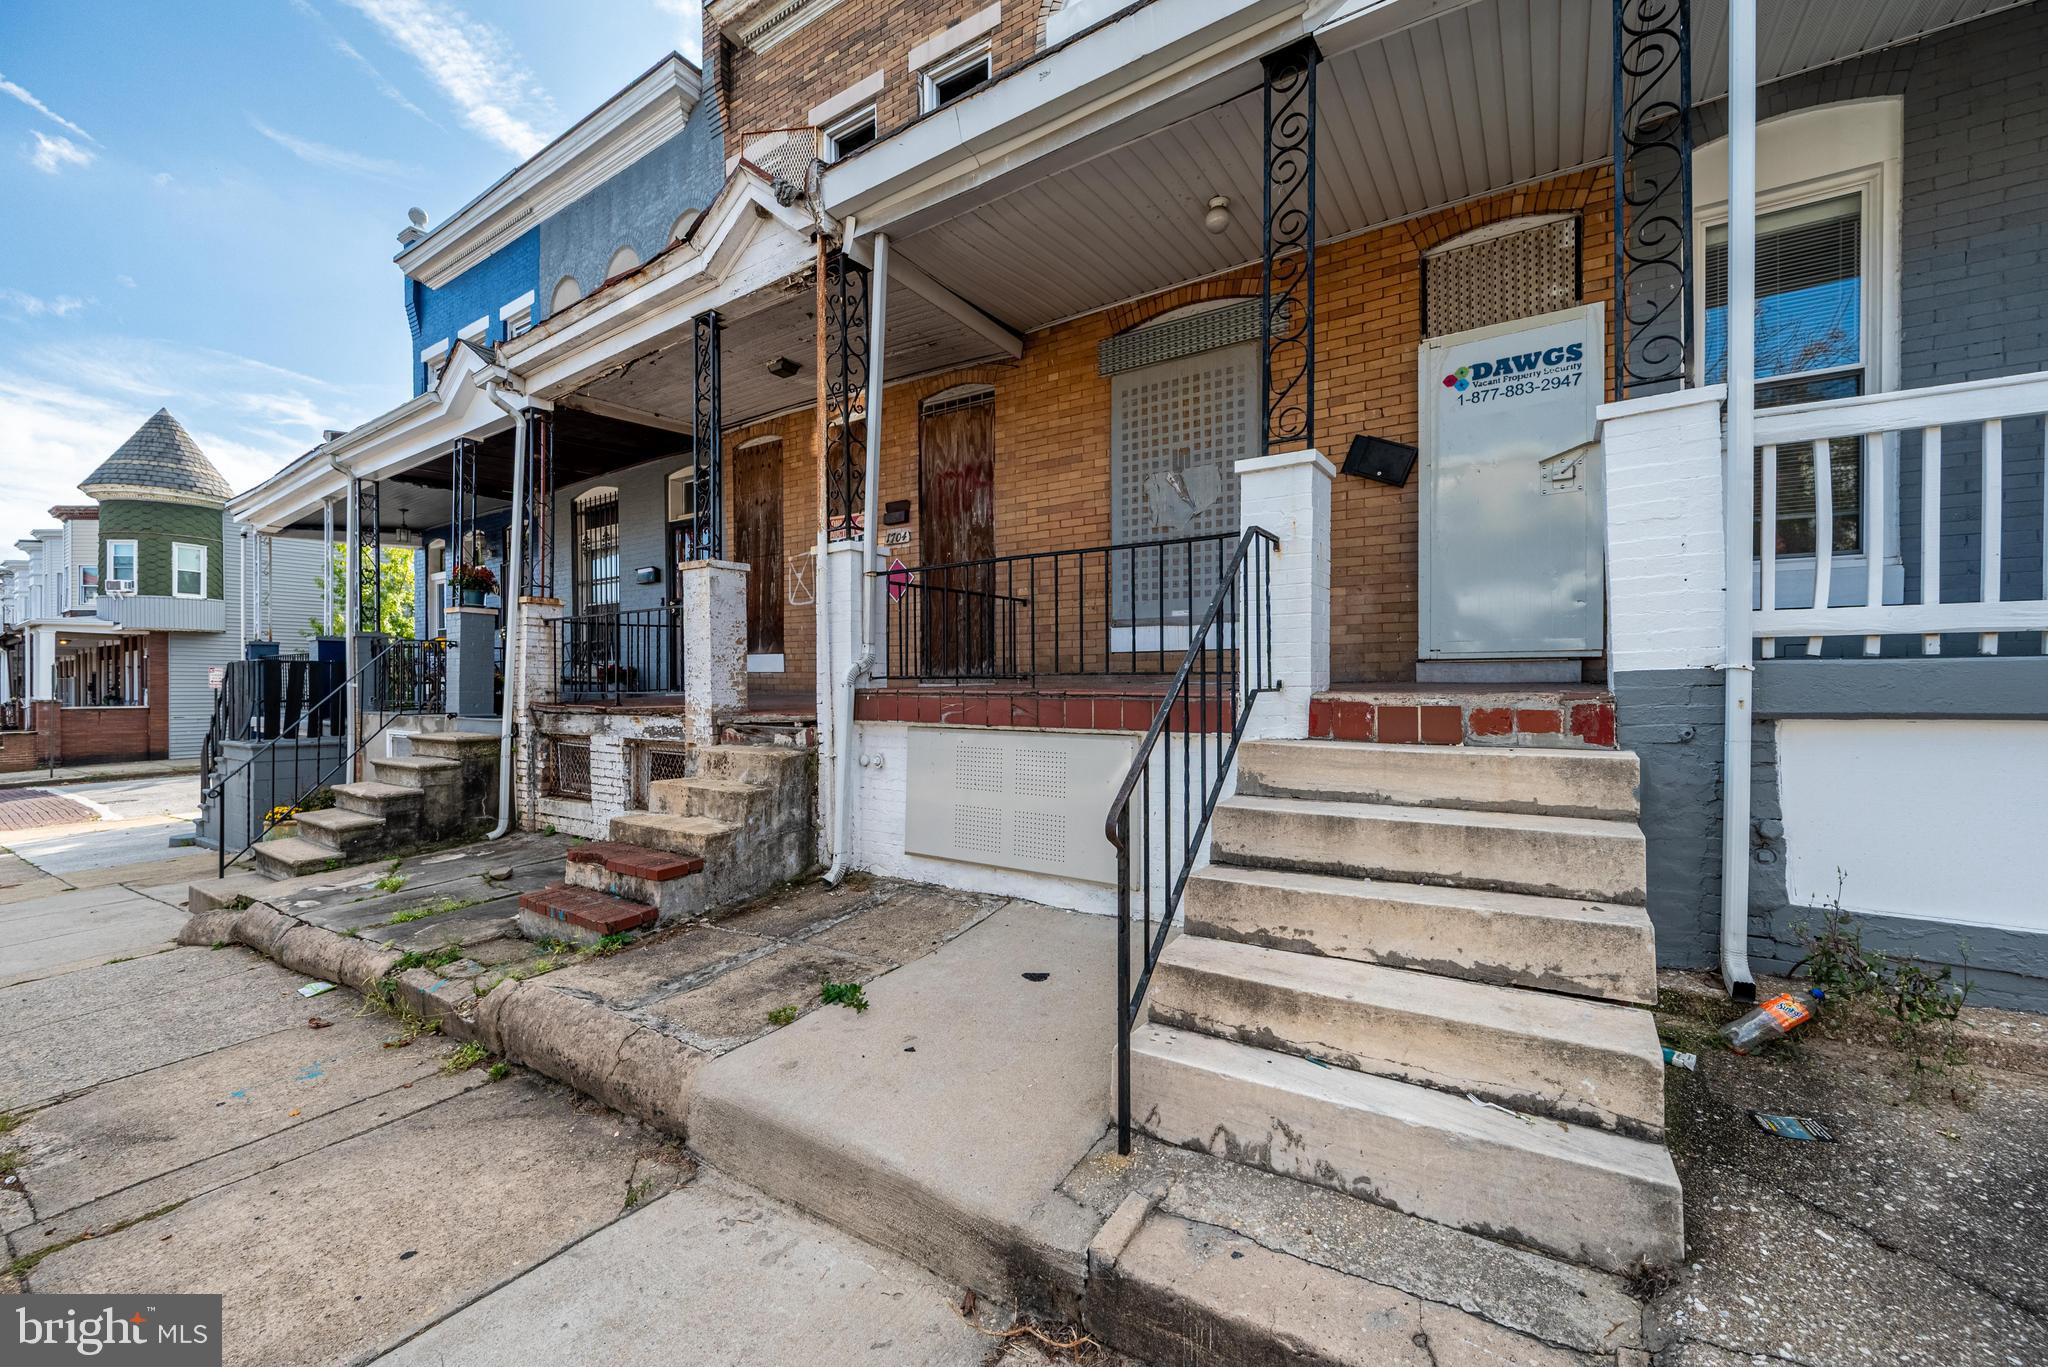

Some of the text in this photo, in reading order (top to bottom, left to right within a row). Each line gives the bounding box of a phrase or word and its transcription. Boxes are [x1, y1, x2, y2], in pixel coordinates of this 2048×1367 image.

[1469, 343, 1583, 380] DAWGS
[1457, 372, 1582, 406] 1-877-883-2947
[1472, 377, 1501, 388] Vacant
[1503, 370, 1541, 383] Property
